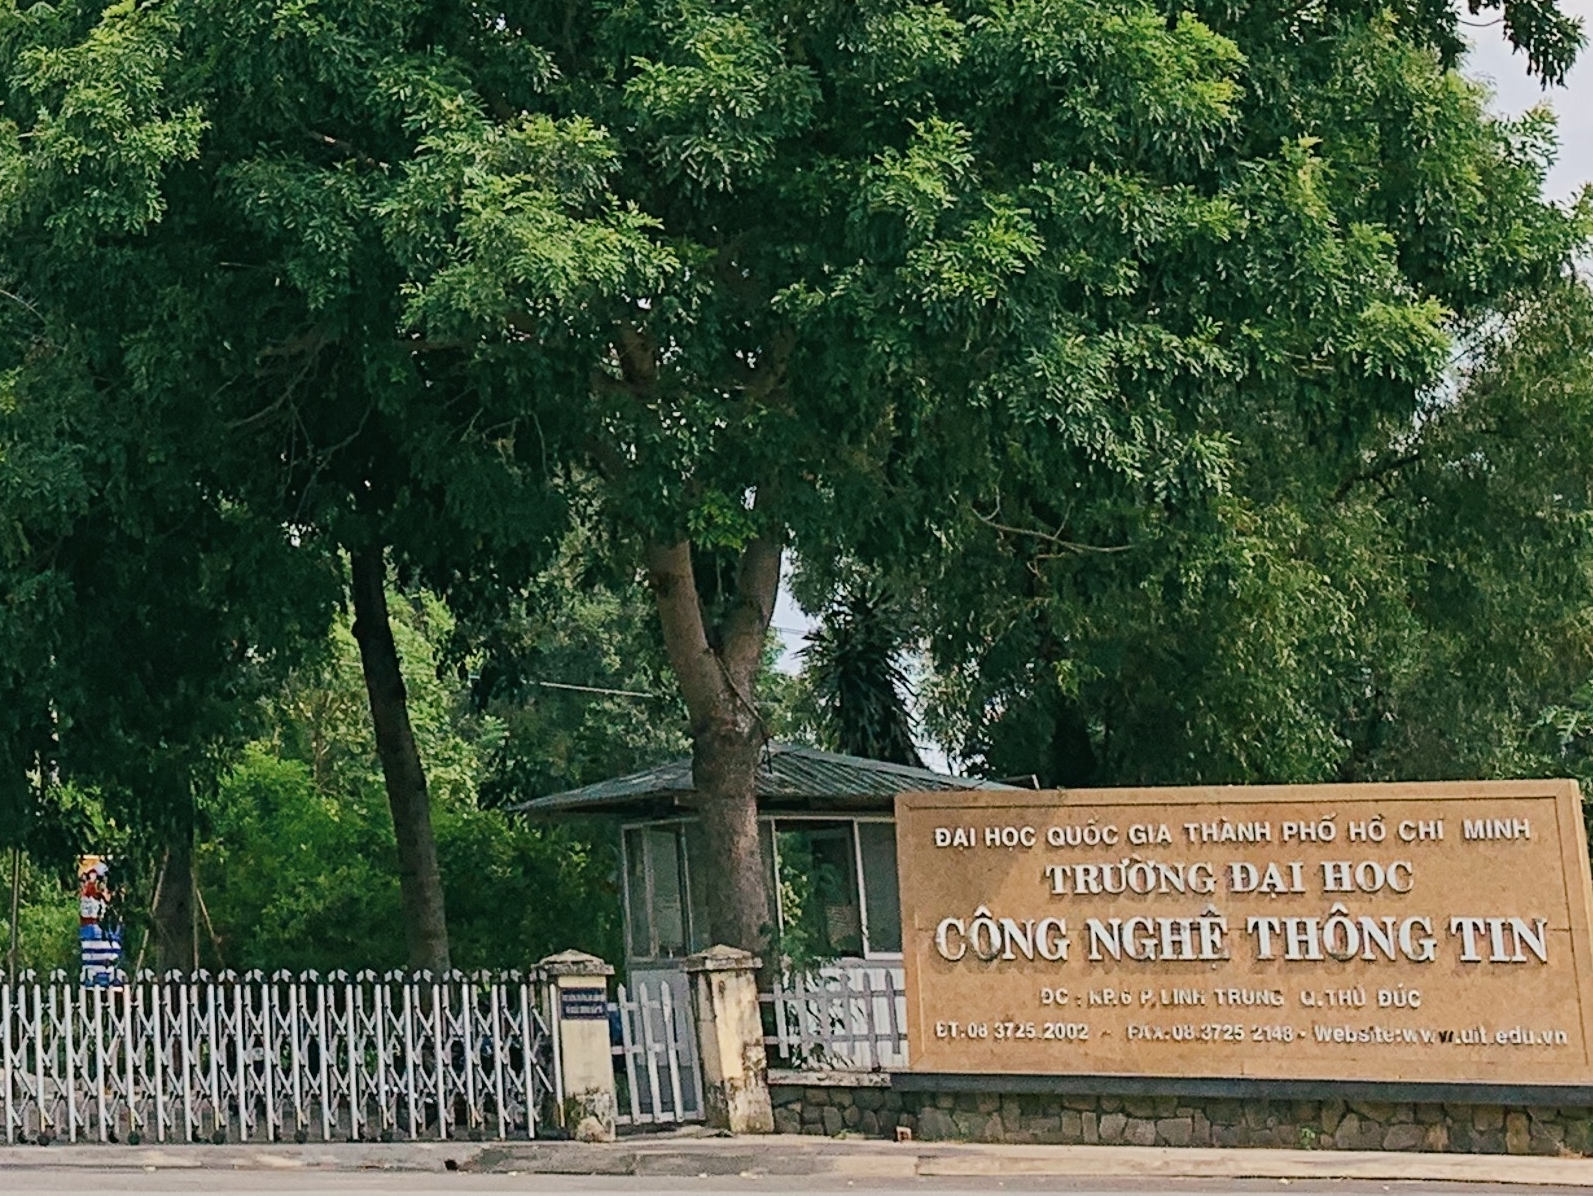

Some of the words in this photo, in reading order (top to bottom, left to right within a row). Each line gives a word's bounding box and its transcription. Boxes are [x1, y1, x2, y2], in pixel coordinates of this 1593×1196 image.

[934, 826, 977, 851] ĐẠI
[985, 825, 1037, 852] HỌC
[1047, 815, 1119, 847] QUỐC
[1127, 822, 1173, 846] GIA
[1183, 815, 1272, 844] THÀNH
[1282, 812, 1338, 842] PHỐ
[1349, 813, 1387, 842] HỒ
[1398, 812, 1444, 842] CHÍ
[1463, 818, 1531, 840] MINH
[1044, 852, 1218, 895] TRƯỜNG
[1227, 860, 1307, 899] ĐẠI
[935, 903, 1072, 963] CÔNG
[1086, 903, 1231, 971] NGHỆ
[1246, 901, 1439, 964] THÔNG
[1449, 915, 1549, 964] TIN
[1214, 988, 1285, 1006] TRUNG
[1377, 983, 1423, 1008] ĐÚC
